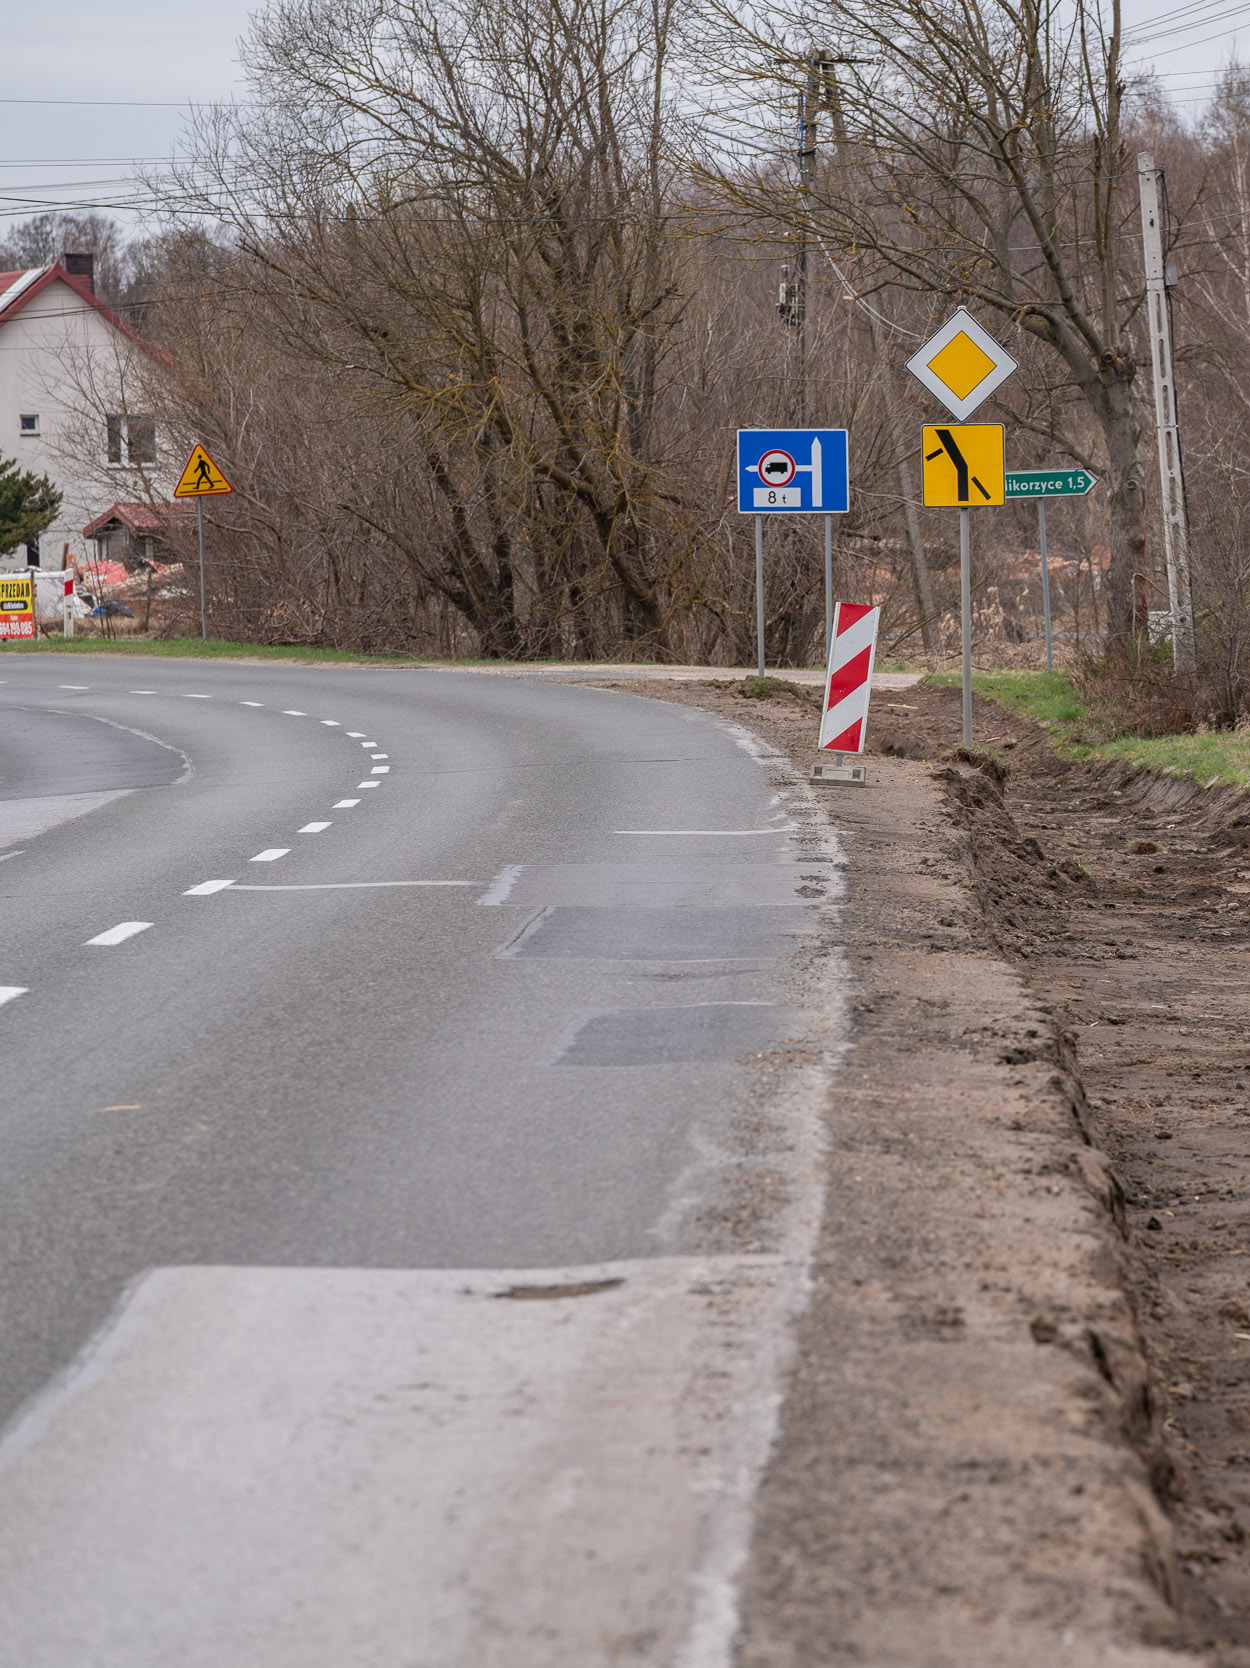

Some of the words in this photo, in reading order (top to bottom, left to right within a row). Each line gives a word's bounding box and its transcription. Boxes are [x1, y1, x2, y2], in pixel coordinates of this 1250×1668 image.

[1067, 476, 1085, 489] 1,5
[768, 491, 777, 504] 8
[782, 494, 787, 504] t
[0, 583, 30, 598] PRZEDAM
